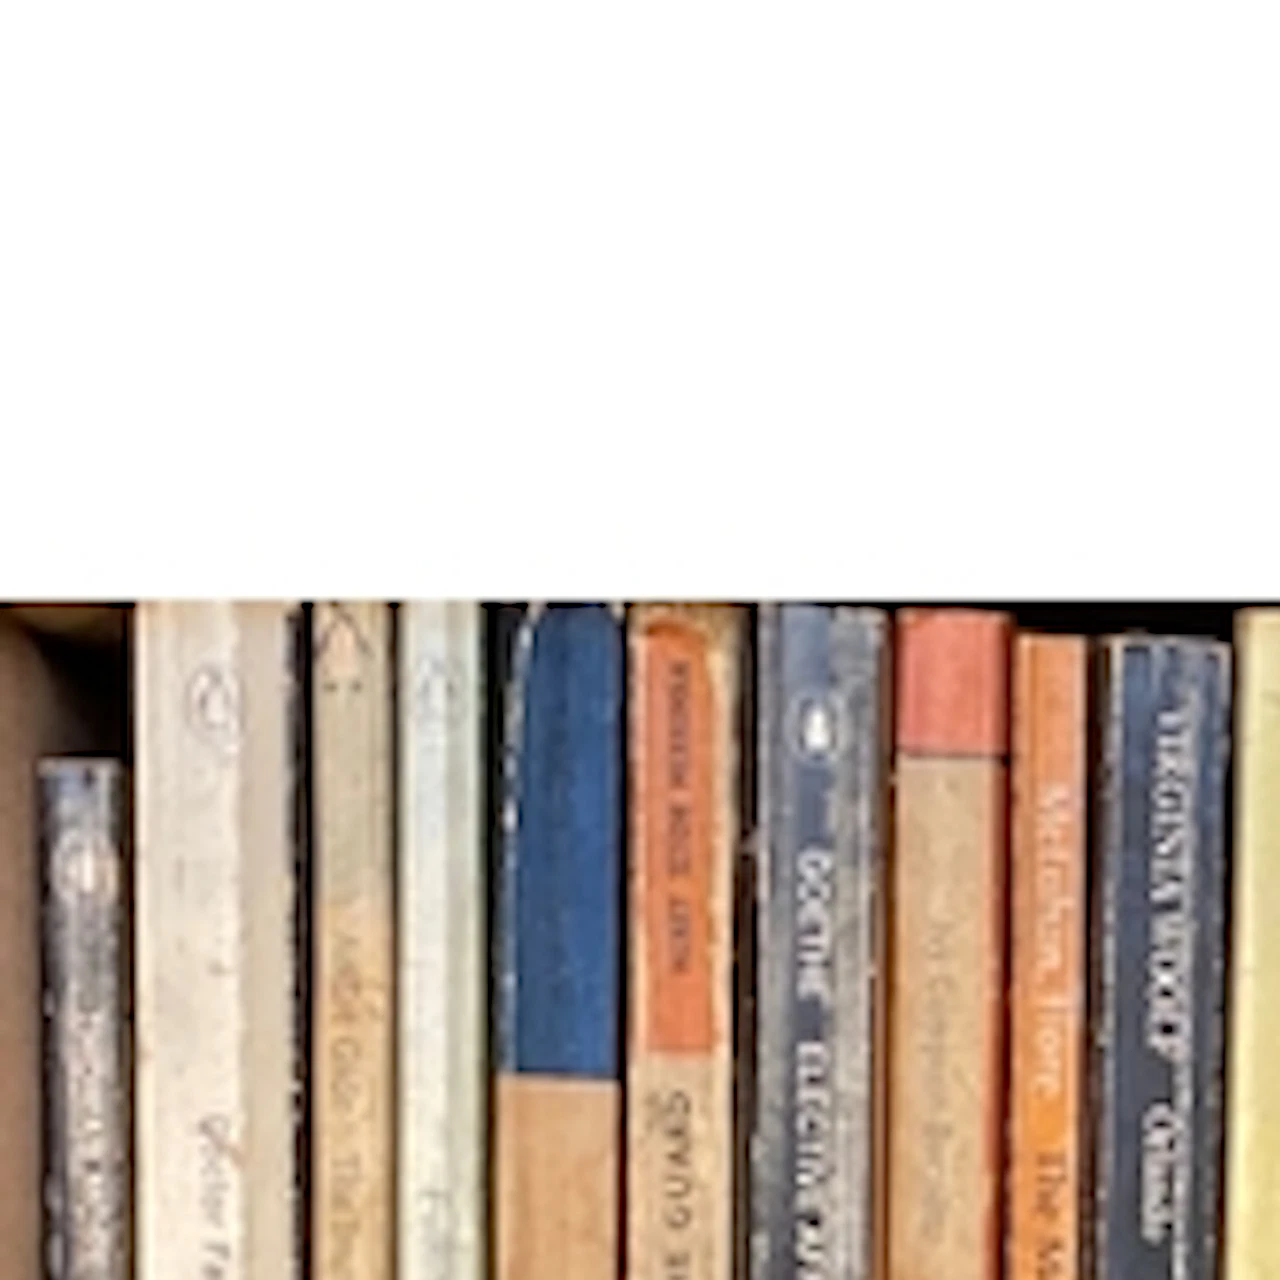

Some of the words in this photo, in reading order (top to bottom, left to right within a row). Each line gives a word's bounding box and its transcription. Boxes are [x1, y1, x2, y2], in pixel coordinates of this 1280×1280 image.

[1149, 702, 1194, 908] VIRGINIA
[795, 849, 832, 1002] GOETHE
[1148, 911, 1192, 1062] WOOLF
[1036, 1151, 1068, 1221] The
[1141, 1103, 1180, 1246] Orlando
